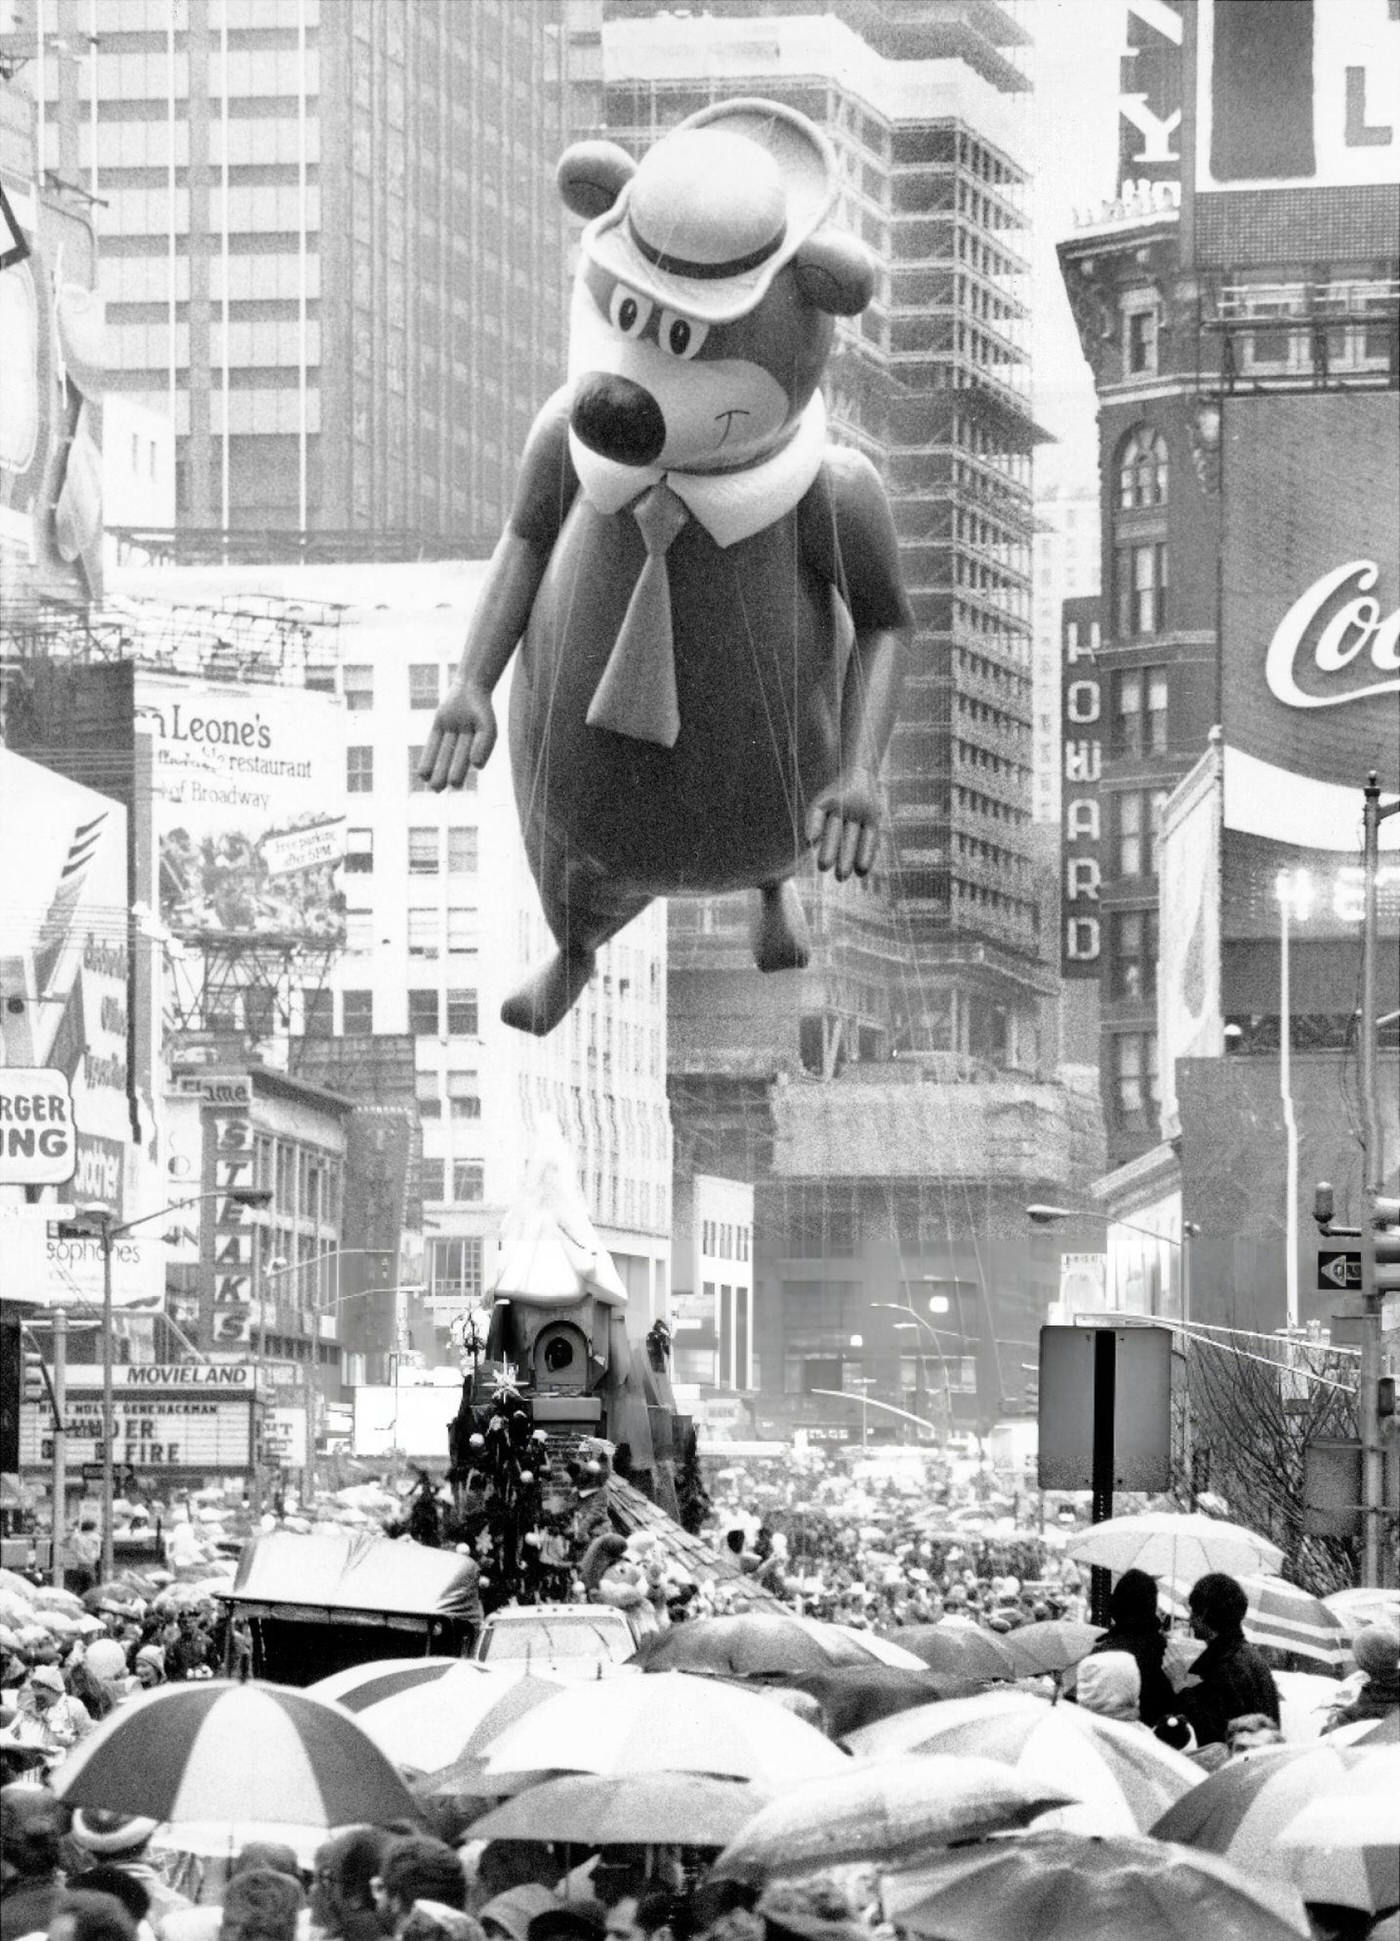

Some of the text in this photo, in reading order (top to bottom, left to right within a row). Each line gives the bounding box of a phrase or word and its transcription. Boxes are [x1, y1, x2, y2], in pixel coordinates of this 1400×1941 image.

[172, 704, 271, 748] Leone's
[229, 755, 312, 778] restaurant
[192, 781, 269, 810] Broadway
[1067, 621, 1100, 960] HOWARD
[217, 1120, 250, 1341] STEAKS
[127, 1366, 247, 1384] MOVIELAND
[124, 1443, 180, 1464] FIRE
